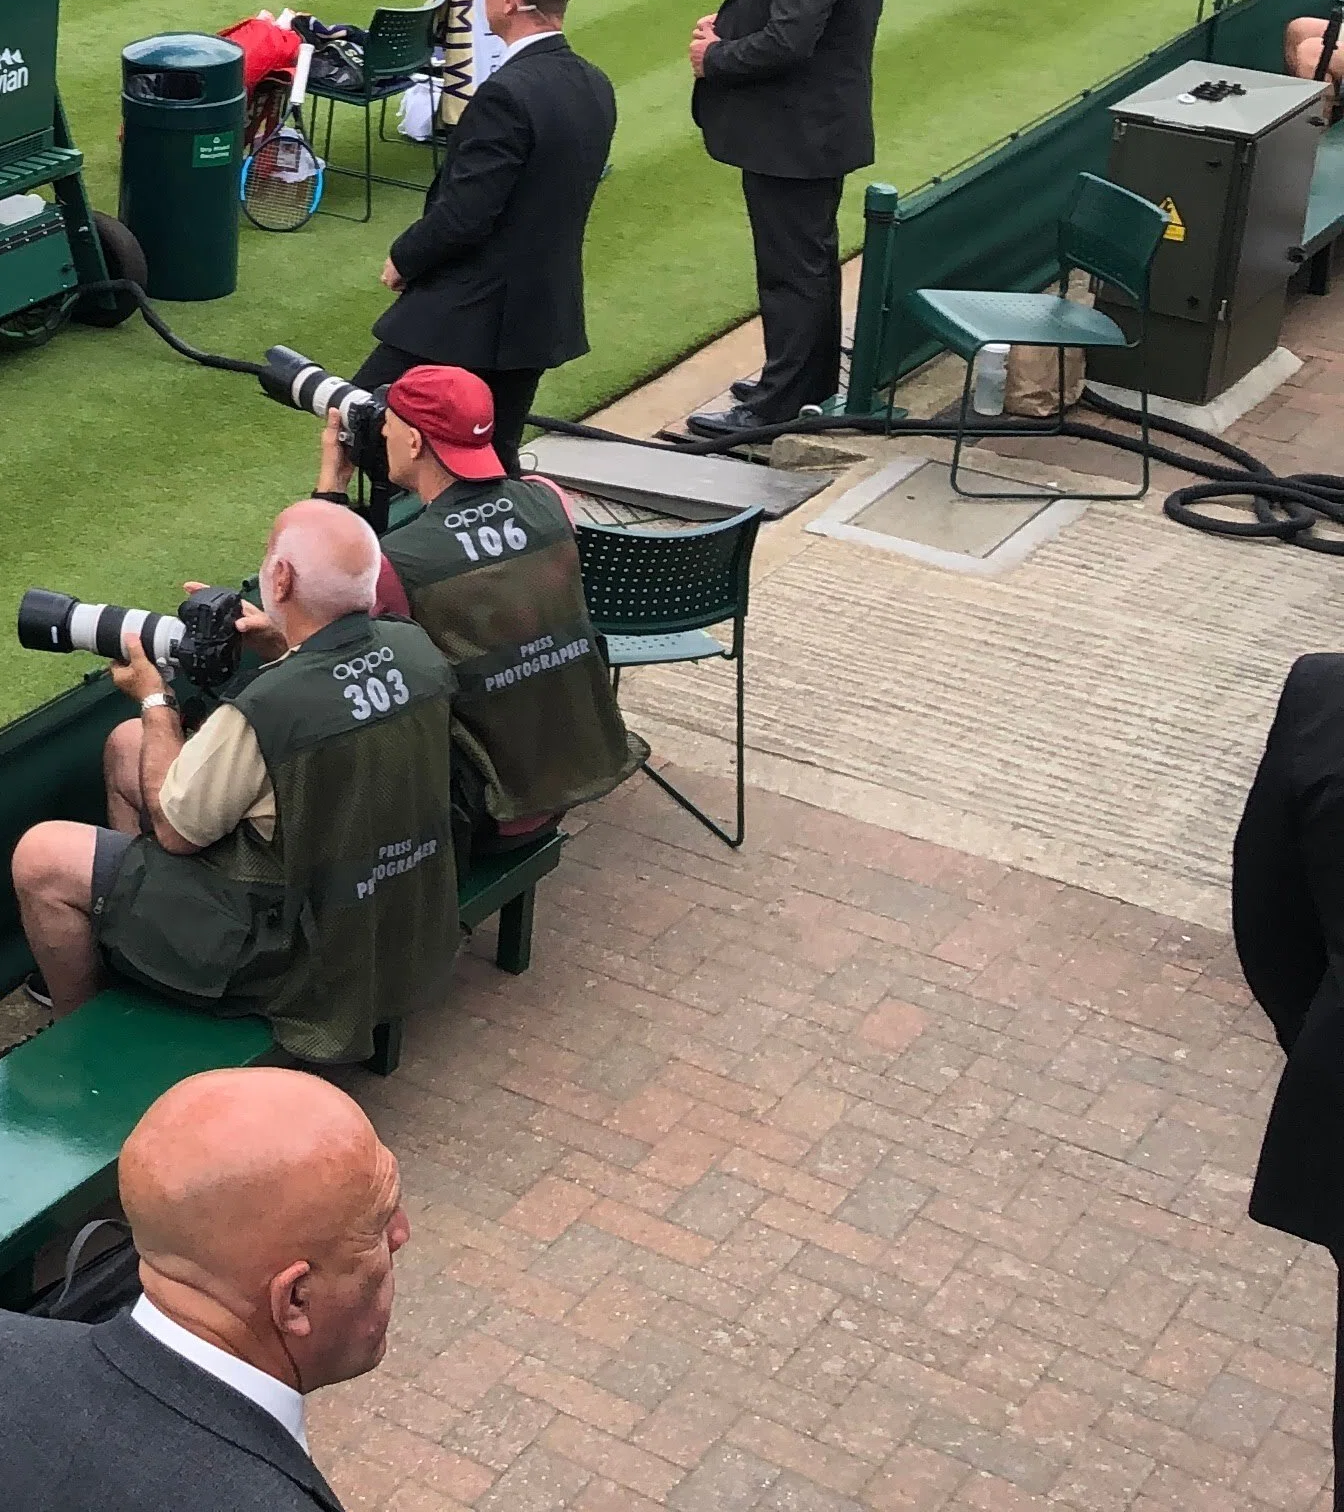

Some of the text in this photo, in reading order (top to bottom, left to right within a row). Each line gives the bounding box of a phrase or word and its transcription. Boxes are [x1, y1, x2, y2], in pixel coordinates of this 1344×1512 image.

[444, 497, 514, 529] oppo
[455, 517, 528, 562] 106
[332, 646, 394, 680] oppo
[520, 635, 554, 658] PRESS
[343, 668, 410, 721] 303
[378, 838, 412, 860] PRESS
